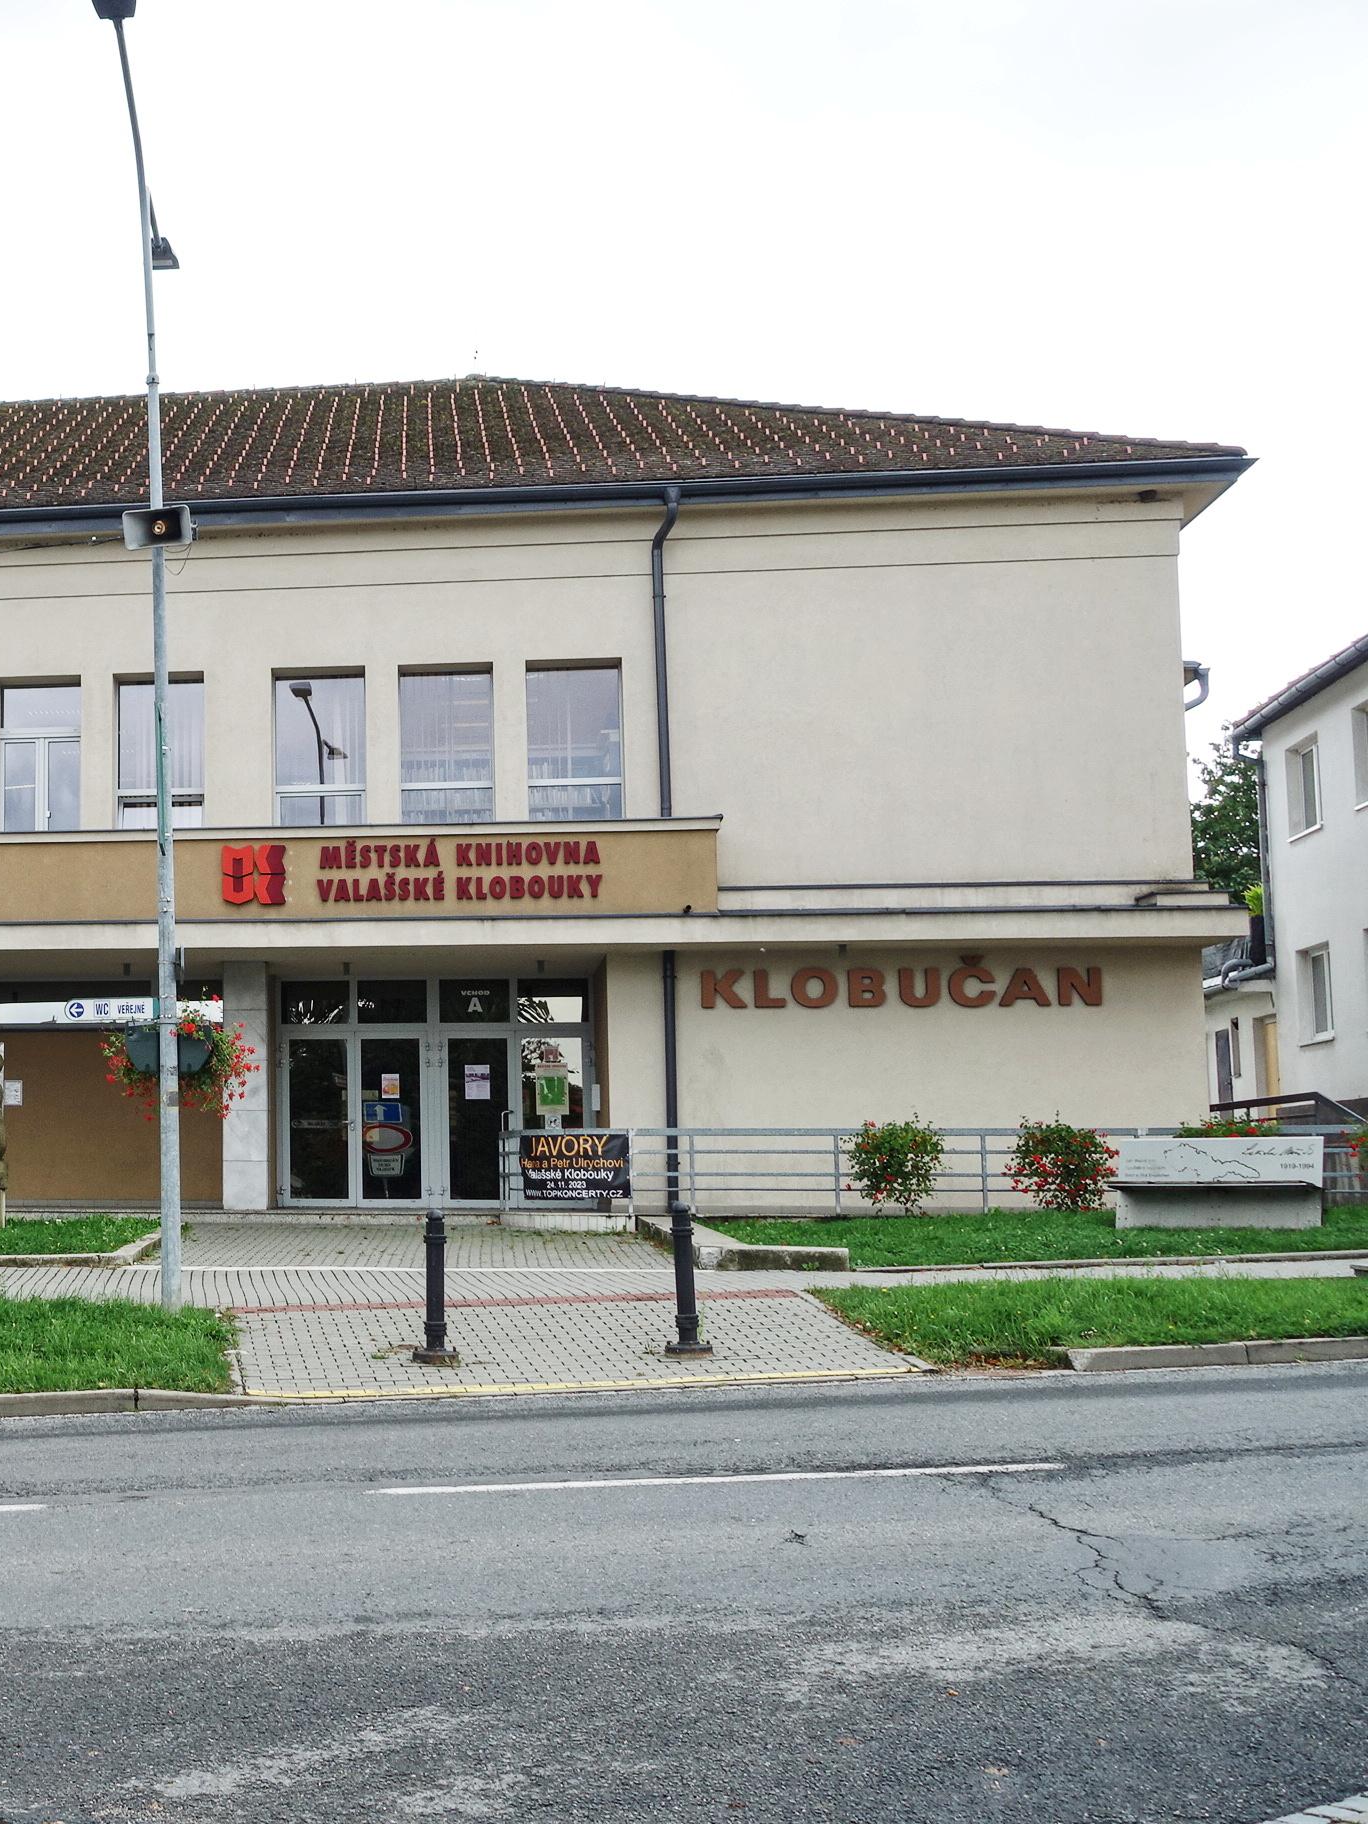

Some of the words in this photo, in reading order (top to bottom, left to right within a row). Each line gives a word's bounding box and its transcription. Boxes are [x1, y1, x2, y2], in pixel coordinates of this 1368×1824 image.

[319, 838, 440, 870] MĚSTSKÁ
[455, 840, 601, 866] KNIHOVNA
[317, 871, 445, 902] VALAŠSKÉ
[455, 873, 603, 900] KLOBOUKY
[700, 954, 1103, 1009] KLOBUČAN
[95, 1003, 109, 1015] WC
[117, 1002, 145, 1014] VEŘEJNÉ
[467, 997, 483, 1012] A
[530, 1135, 608, 1157] JAVORY
[542, 1160, 548, 1168] a
[550, 1158, 570, 1168] Petr
[572, 1157, 624, 1170] Ulrychovi
[525, 1169, 562, 1180] Valašské
[564, 1168, 614, 1181] Klobouky
[568, 1180, 586, 1188] 2023
